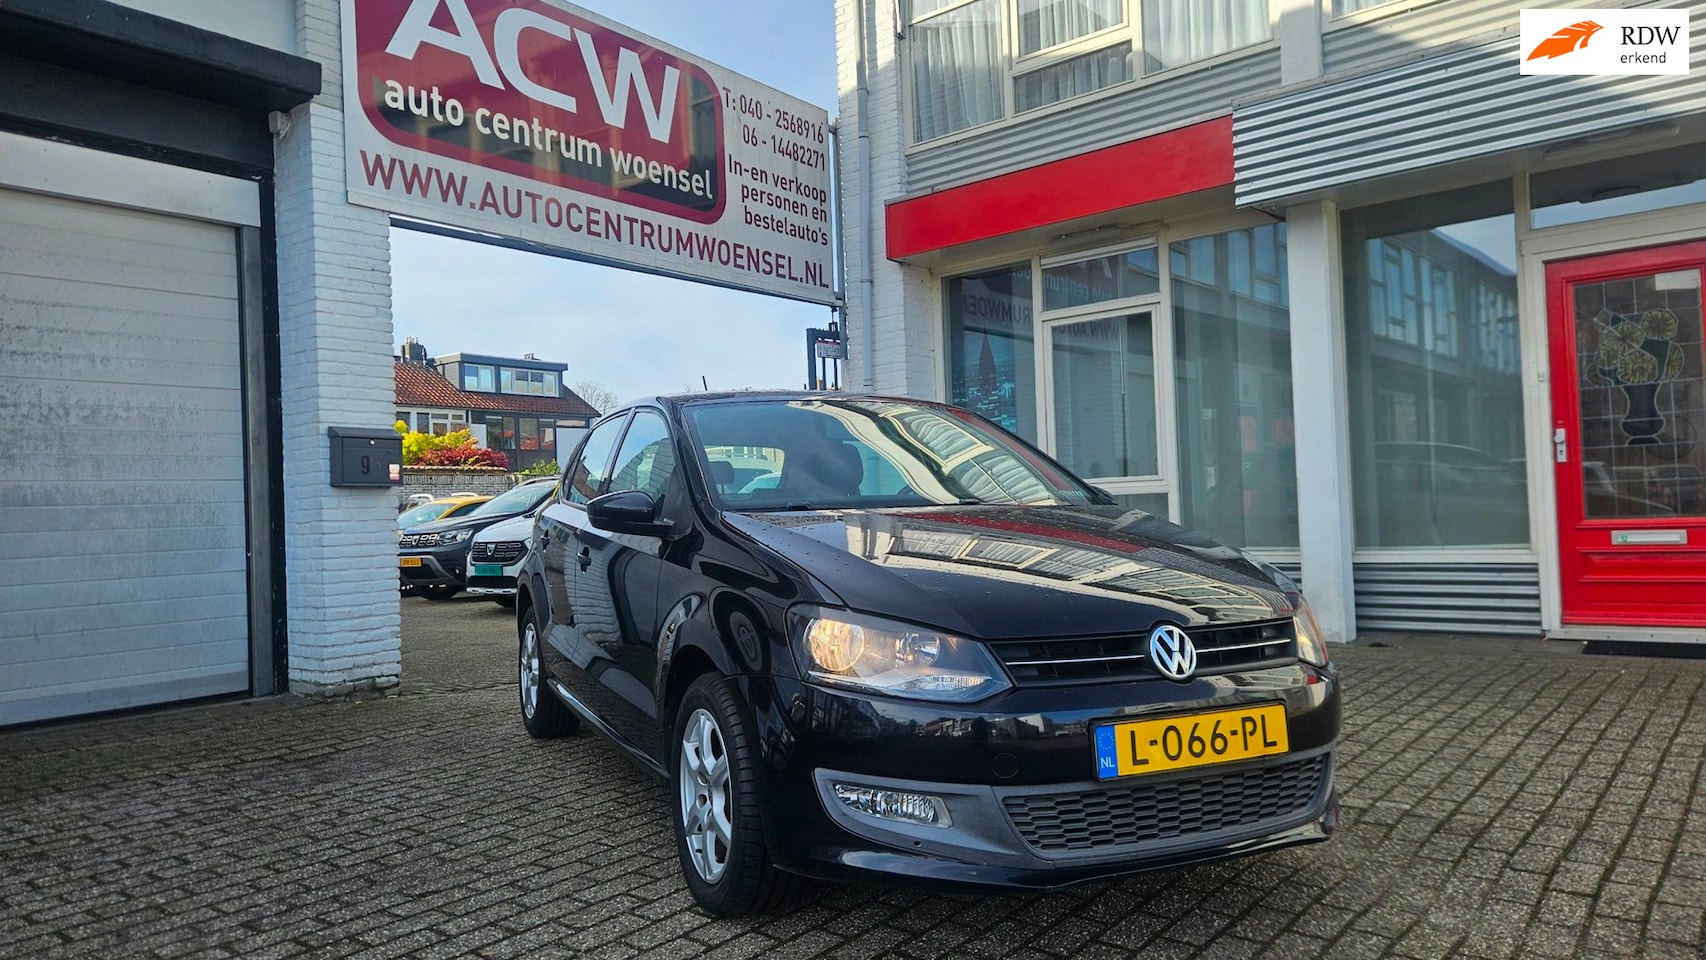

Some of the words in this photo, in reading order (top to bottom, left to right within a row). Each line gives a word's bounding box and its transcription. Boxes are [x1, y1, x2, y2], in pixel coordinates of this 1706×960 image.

[385, 0, 680, 143] ACW
[384, 79, 465, 127] auto
[475, 107, 601, 168] centrum
[609, 147, 713, 199] woensel
[739, 94, 763, 121] 040
[775, 108, 824, 144] 2568916
[742, 124, 758, 147] 06
[771, 134, 826, 172] 14482271
[728, 153, 768, 185] In-en
[772, 172, 827, 206] verkoop
[741, 183, 808, 217] personen
[811, 208, 827, 223] en
[359, 149, 829, 289] WWW.AUTOCENTRUMWOENSEL.NL
[744, 205, 828, 246] bestelauto's
[1100, 757, 1115, 768] NL
[1130, 714, 1277, 766] L-066-PL
